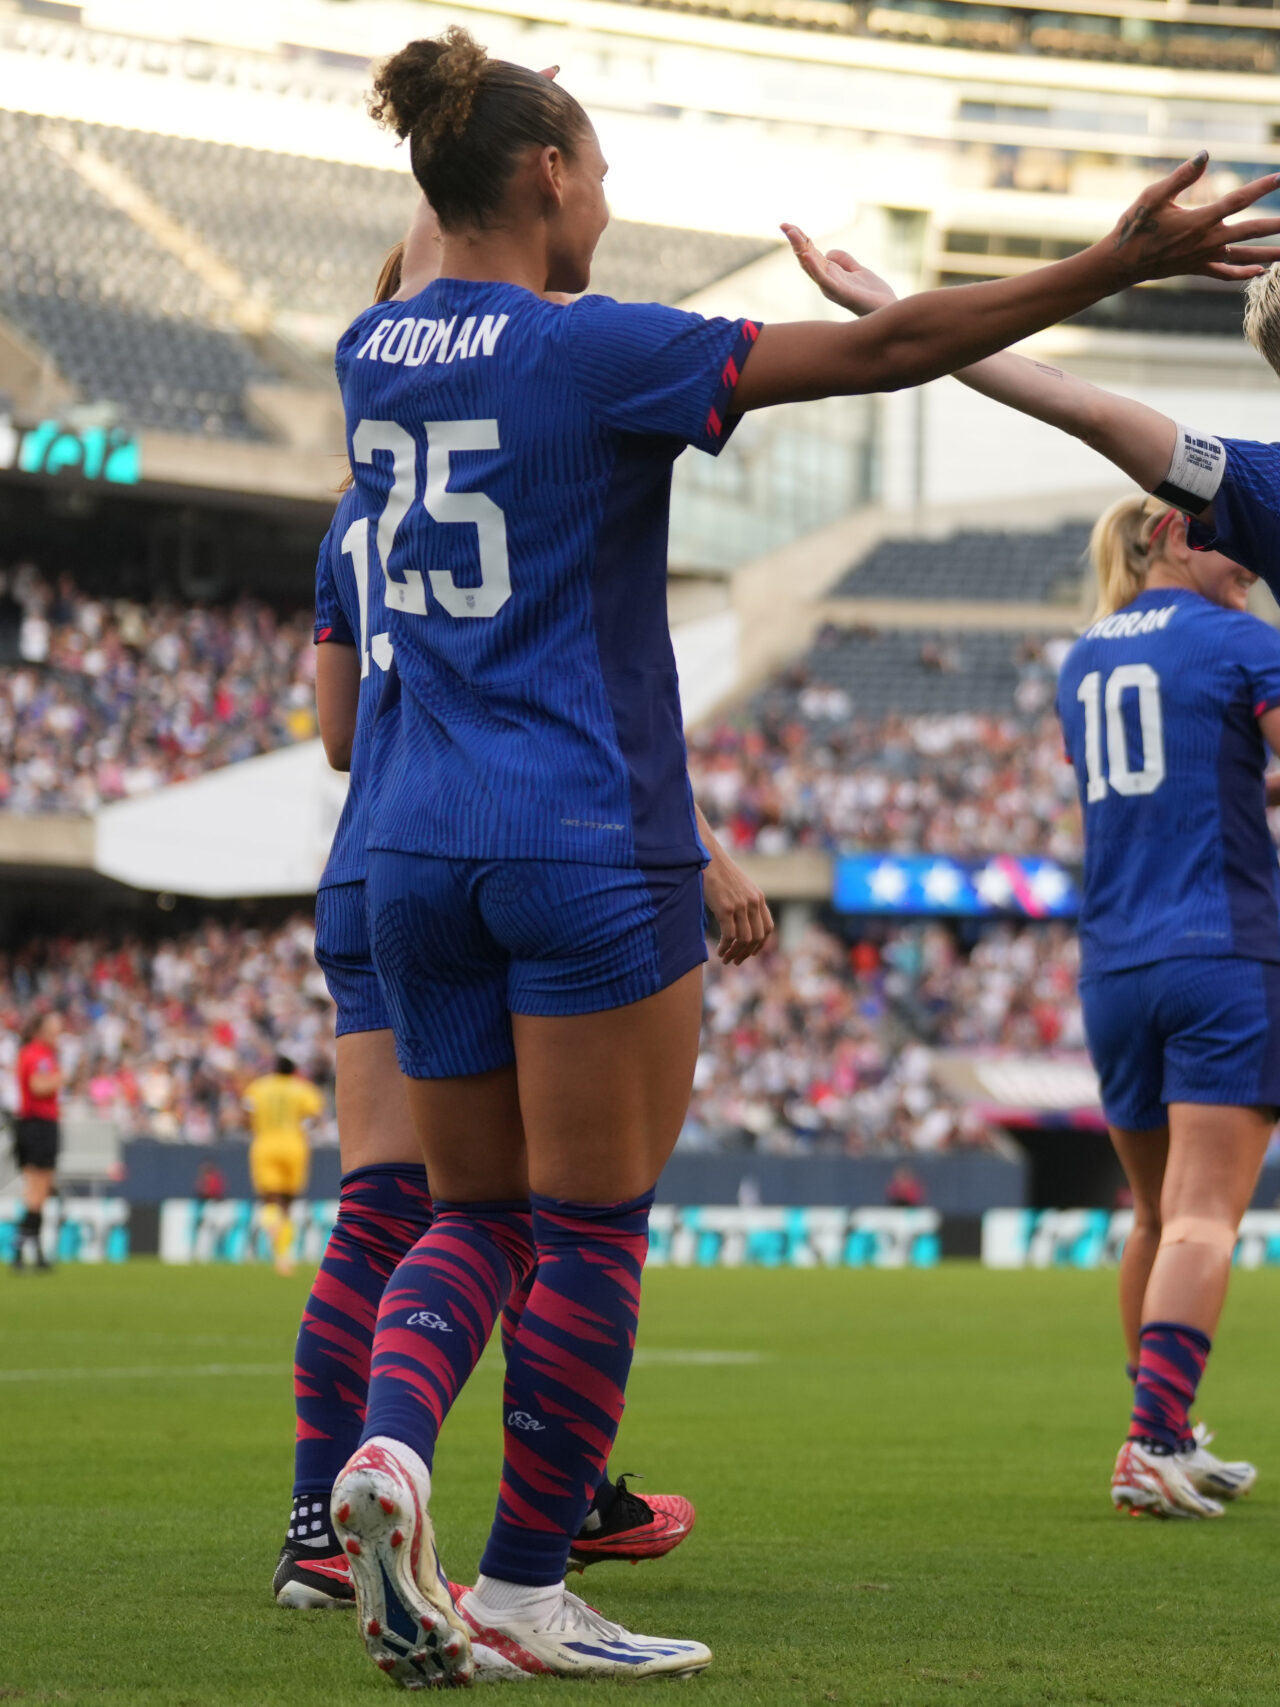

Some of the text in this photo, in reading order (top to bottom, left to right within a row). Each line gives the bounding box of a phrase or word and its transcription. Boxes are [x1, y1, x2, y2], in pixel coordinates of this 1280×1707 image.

[357, 314, 509, 366] RODMAN
[352, 419, 512, 617] 25
[1077, 663, 1165, 803] 10
